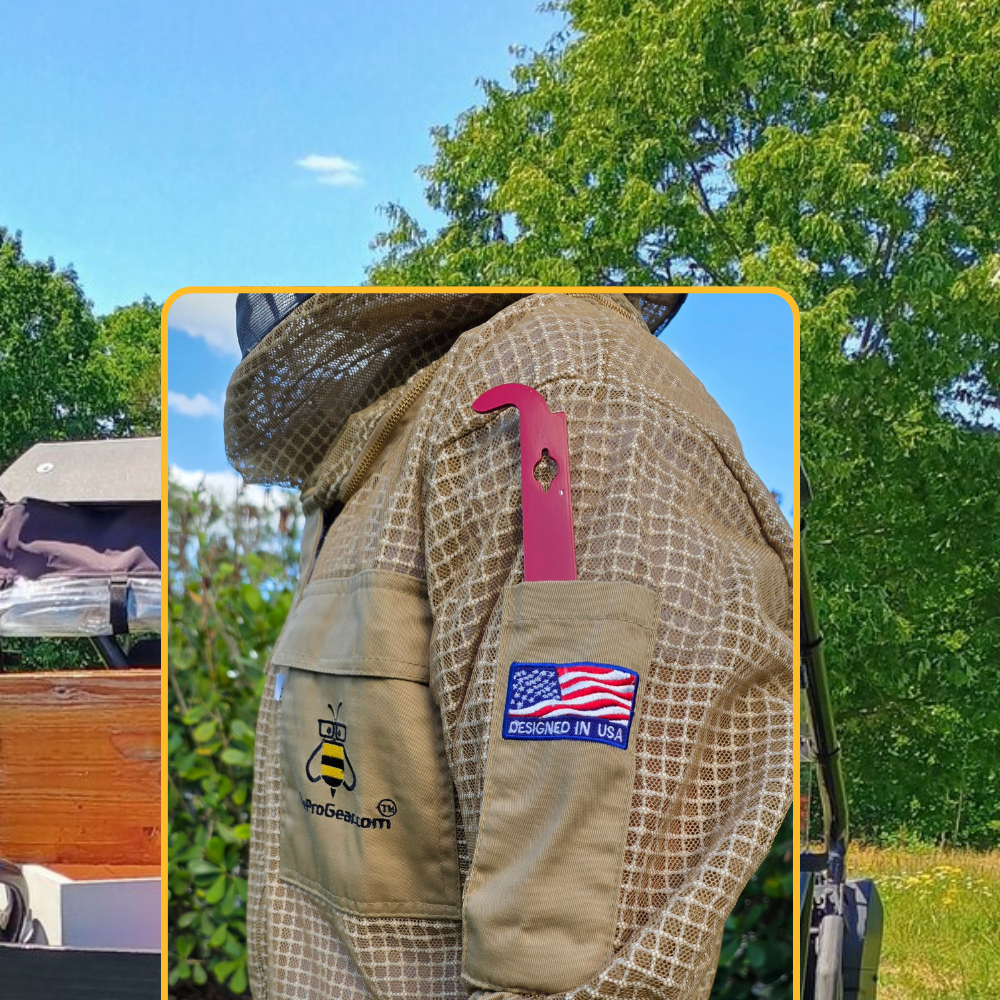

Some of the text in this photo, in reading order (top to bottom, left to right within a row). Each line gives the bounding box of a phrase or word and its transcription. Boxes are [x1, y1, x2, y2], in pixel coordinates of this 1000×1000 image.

[508, 720, 623, 743] DESIGNED IN USA
